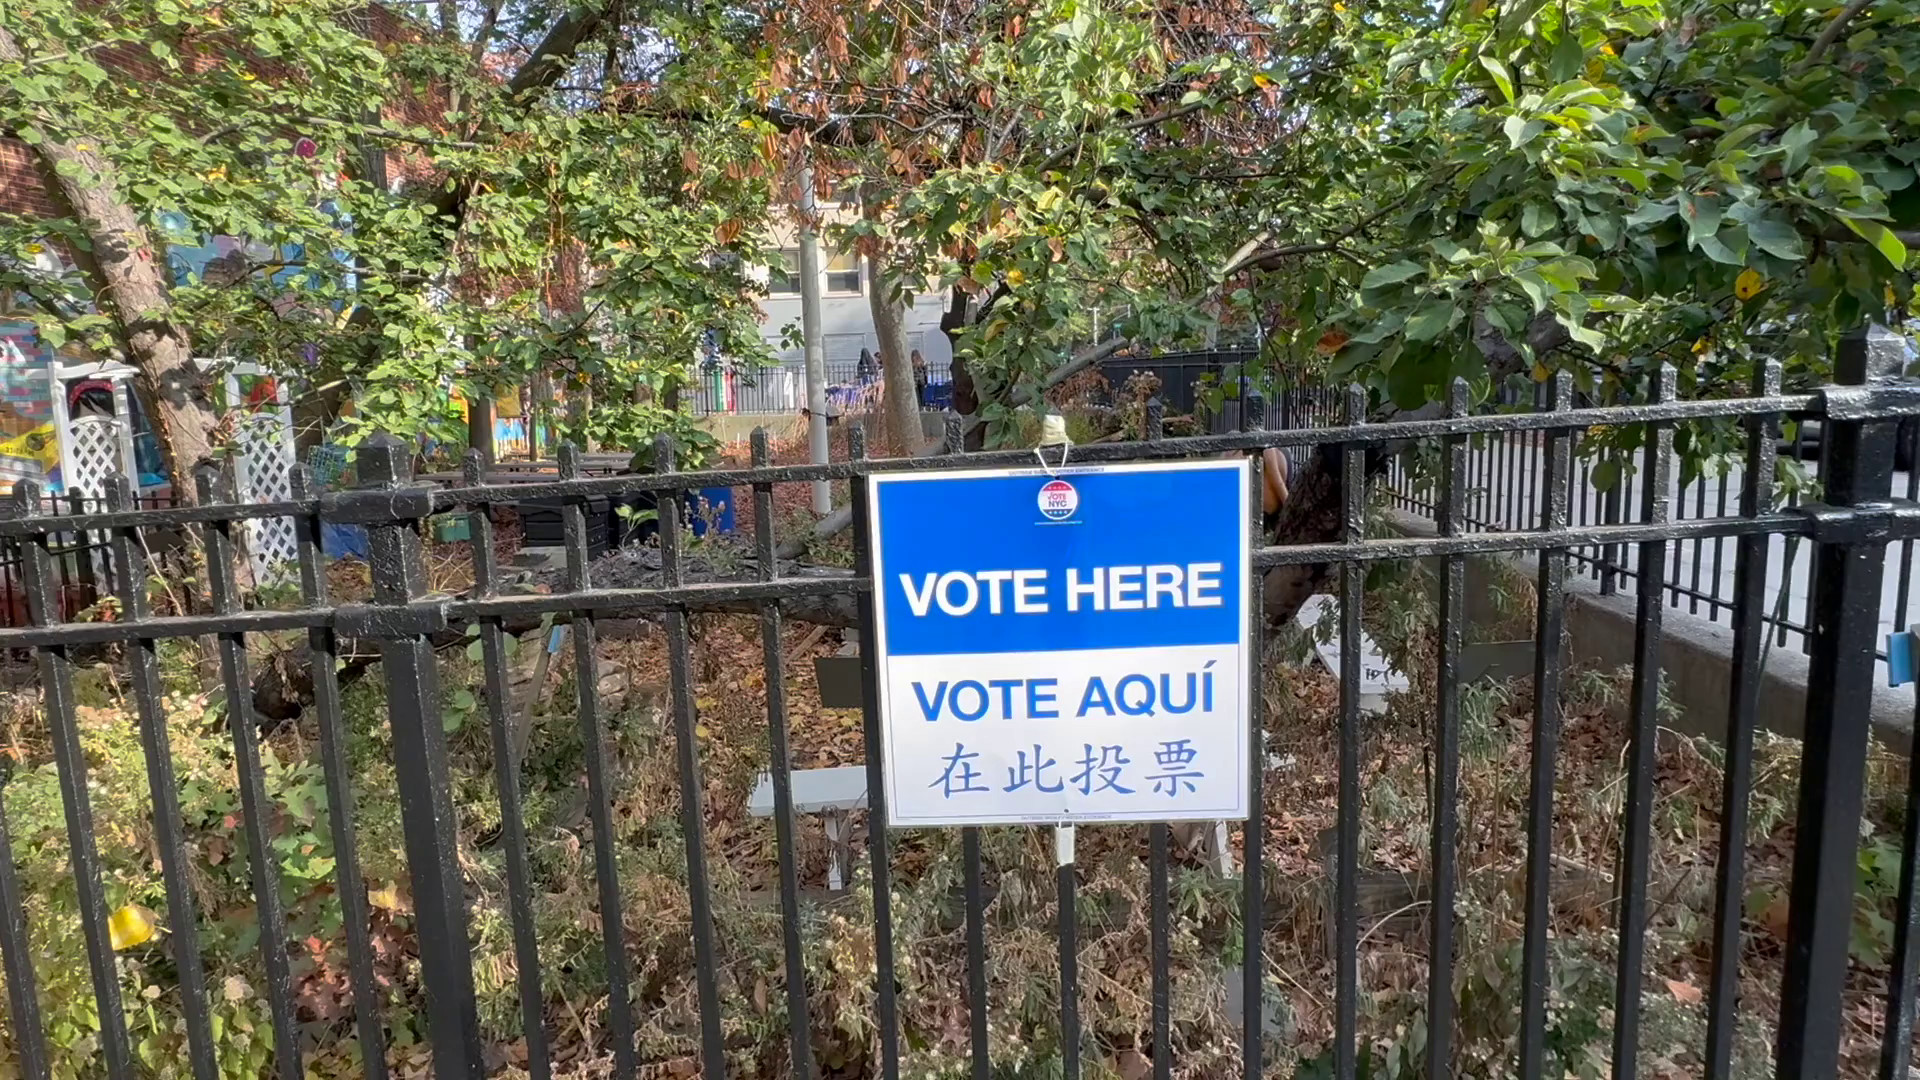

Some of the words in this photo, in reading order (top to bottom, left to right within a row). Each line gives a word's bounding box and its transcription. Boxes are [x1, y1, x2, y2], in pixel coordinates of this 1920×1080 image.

[1048, 500, 1068, 508] NYC
[899, 569, 1049, 617] VOTE
[1066, 562, 1223, 612] HERE
[911, 678, 1058, 721] VOTE
[1076, 660, 1217, 717] AQUÍ
[928, 740, 1205, 800] 在此投票
